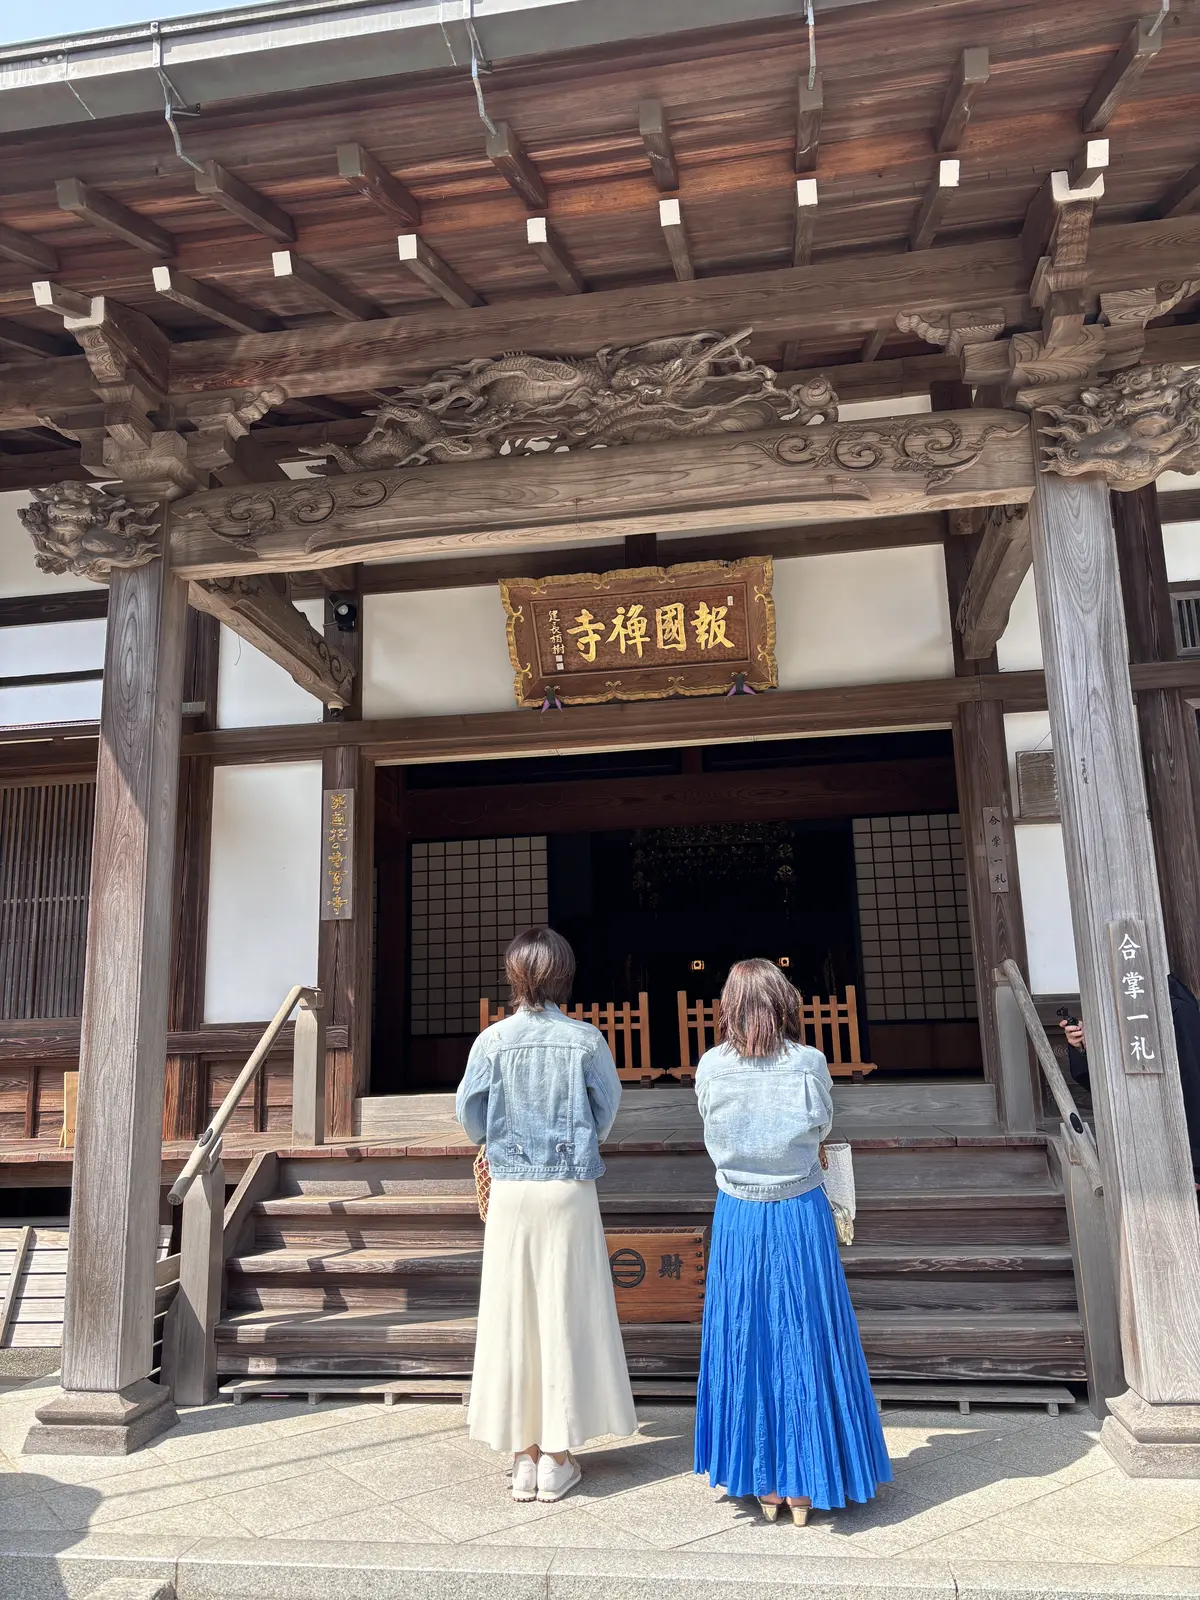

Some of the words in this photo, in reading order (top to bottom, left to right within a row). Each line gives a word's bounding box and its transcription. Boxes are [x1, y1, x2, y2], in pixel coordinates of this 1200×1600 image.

[1118, 934, 1155, 1061] 合掌一礼
[658, 1253, 684, 1280] 財
